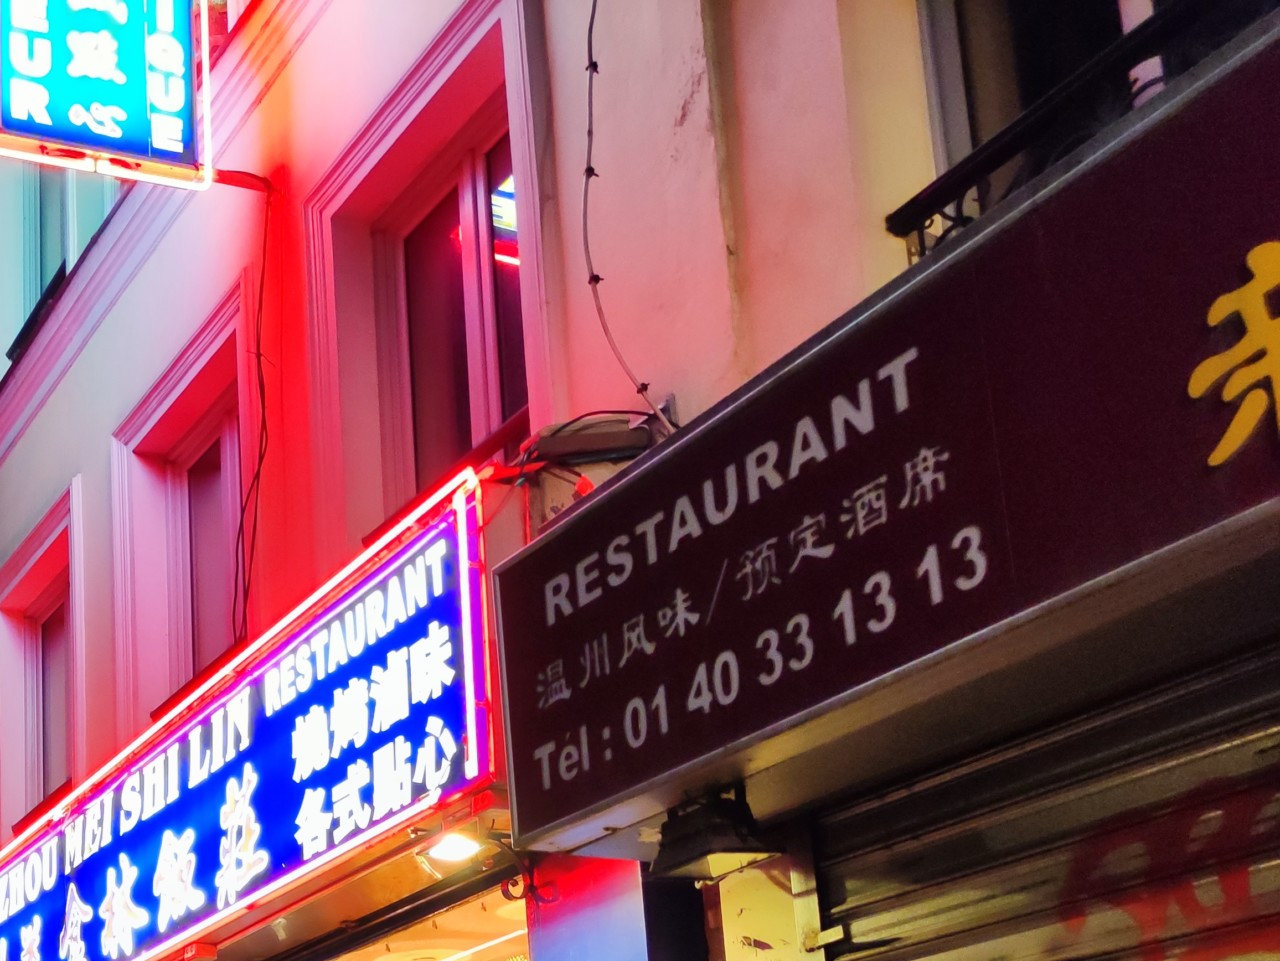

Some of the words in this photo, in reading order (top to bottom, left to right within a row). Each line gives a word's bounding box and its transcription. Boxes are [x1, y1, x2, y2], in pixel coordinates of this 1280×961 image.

[544, 346, 919, 627] RESTAURANT
[64, 791, 114, 876] MEI
[119, 743, 180, 836] SHI
[188, 687, 250, 788] LIN
[263, 539, 446, 716] RESTAURANT
[624, 683, 669, 751] 01
[687, 649, 740, 714] 40
[756, 613, 815, 686] 33
[832, 571, 897, 647] 13
[916, 524, 988, 604] 13
